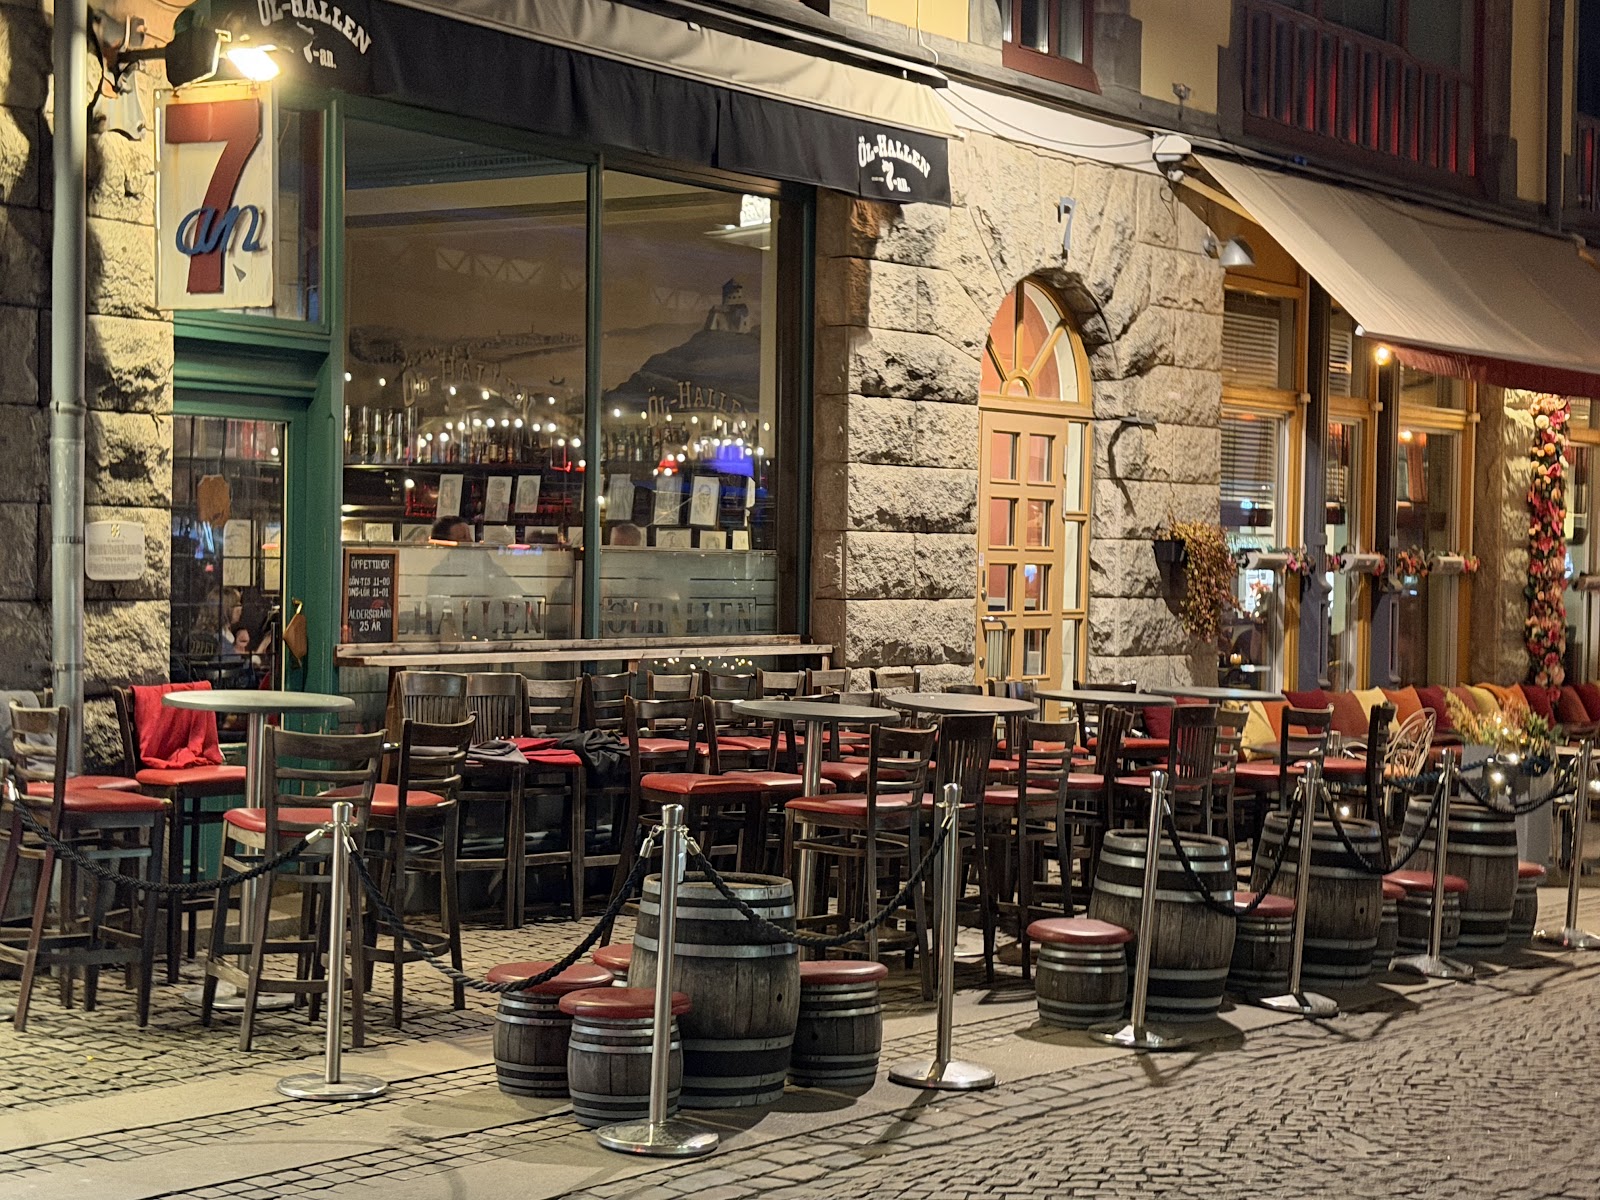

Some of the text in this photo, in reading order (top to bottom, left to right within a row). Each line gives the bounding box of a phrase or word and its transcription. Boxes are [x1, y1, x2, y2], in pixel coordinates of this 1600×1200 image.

[857, 134, 931, 179] ÖL-HALLEN
[165, 98, 262, 294] 7
[175, 204, 263, 256] an
[359, 618, 382, 632] 25 ÅR
